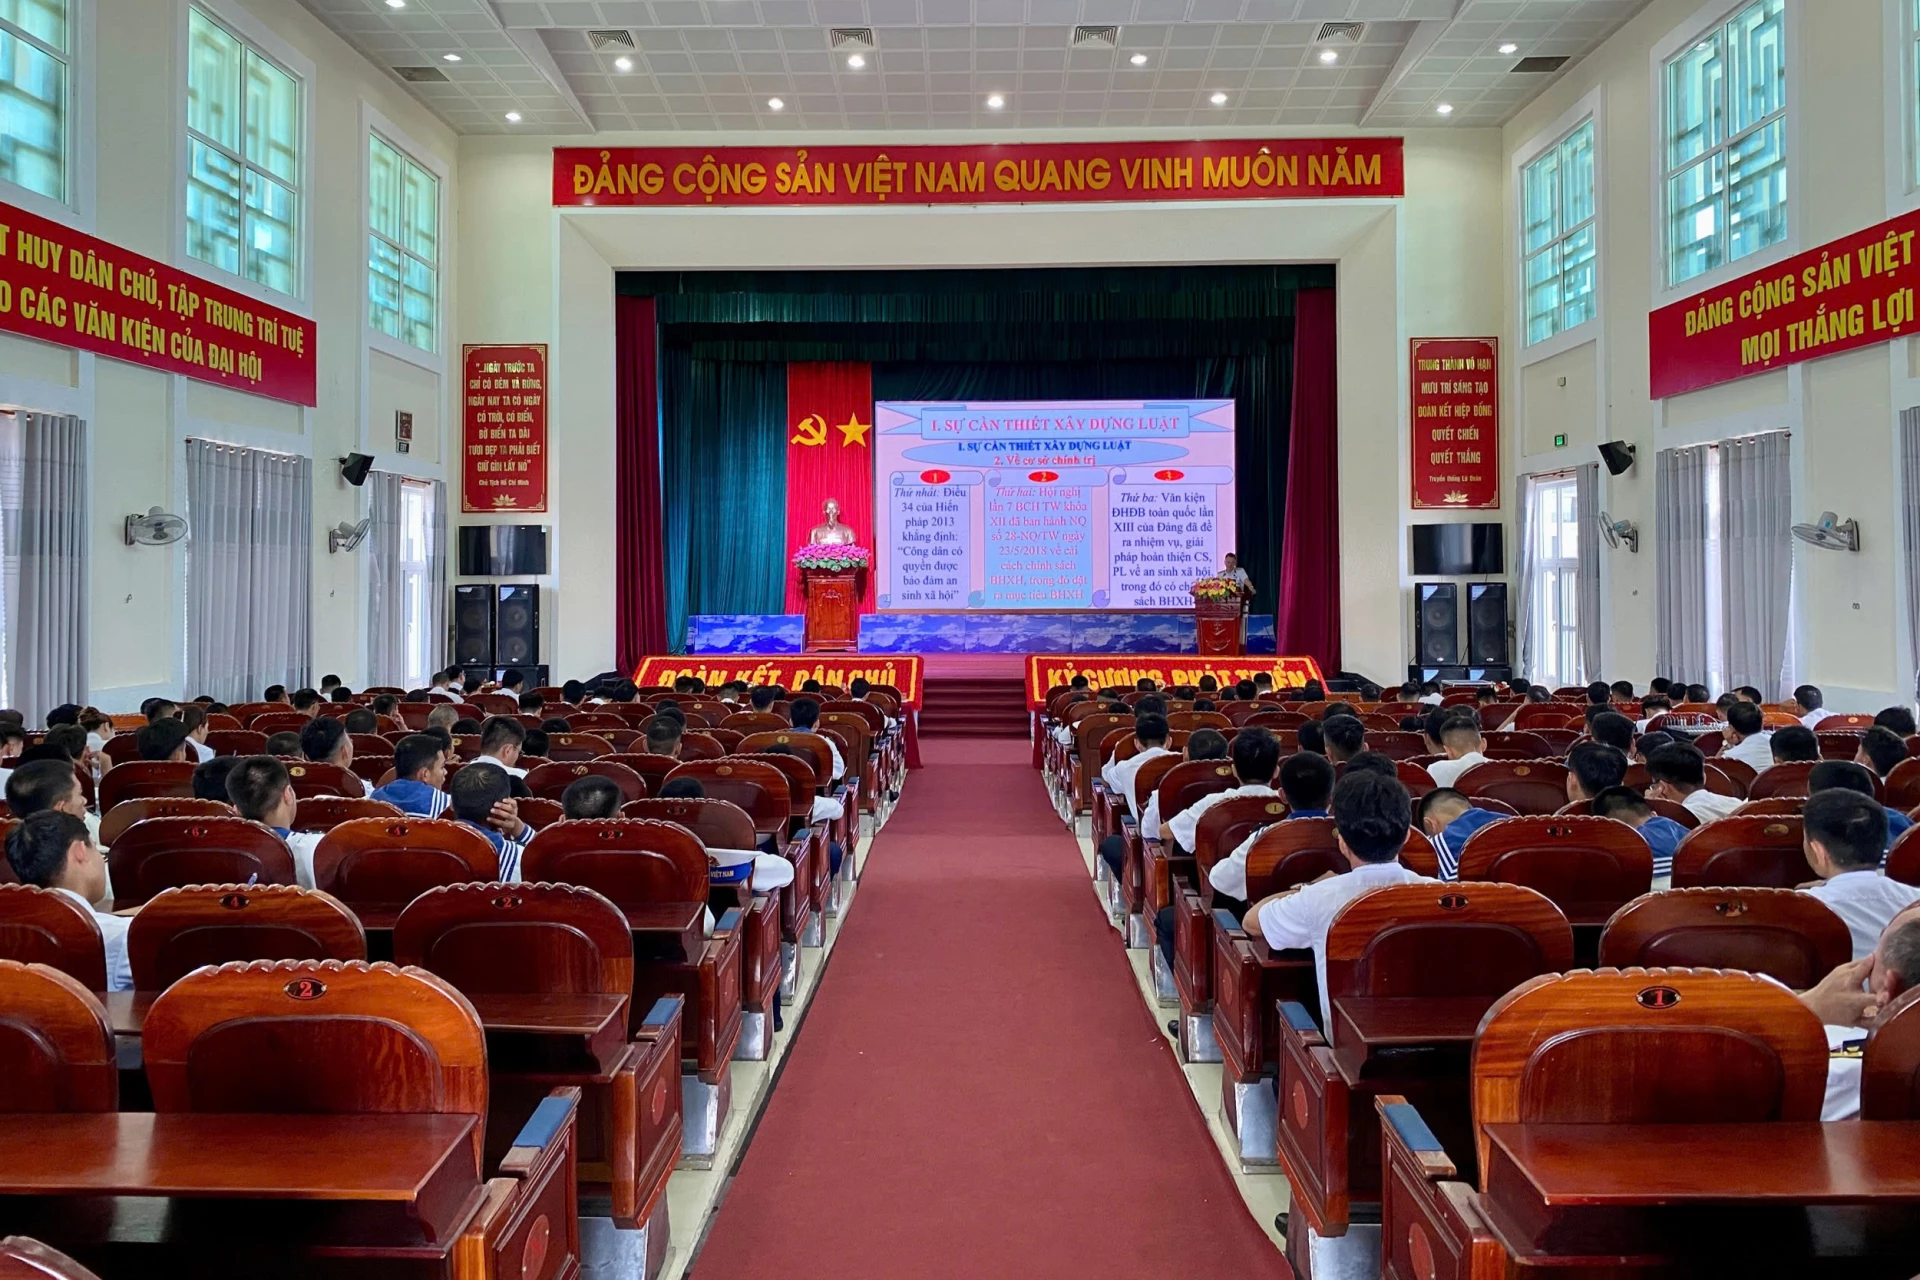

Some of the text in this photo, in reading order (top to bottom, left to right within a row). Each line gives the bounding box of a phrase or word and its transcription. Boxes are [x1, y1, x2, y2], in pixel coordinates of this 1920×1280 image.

[574, 146, 1381, 202] ĐẢNG CỘNG SẢN VIỆT NAM QUANG VINH MUÔN NĂM
[1685, 230, 1915, 337] ĐẢNG CỘNG SẢN VIỆT
[18, 230, 63, 274] HUY
[70, 249, 113, 291] DÂN
[120, 268, 162, 310] CHỦ,
[168, 284, 199, 321] TẬP
[204, 298, 253, 336] TRUNG
[257, 316, 278, 346] TRÍ
[282, 325, 304, 358] TUỆ
[1742, 288, 1914, 366] MỌI THẮNG LỢI
[20, 286, 66, 328] CÁC
[73, 300, 115, 341] VĂN
[122, 317, 165, 357] KIỆN
[170, 328, 204, 365] CỦA
[209, 343, 234, 377] ĐẠI
[238, 351, 262, 384] HỘI
[1418, 359, 1439, 370] TRUNG
[1442, 357, 1464, 370] THÀNH
[1477, 359, 1491, 372] HẠN
[1421, 380, 1488, 395] MƯU TRÍ SÁNG TẠO
[488, 394, 540, 406] NAY TA CÓ NGÀY
[1418, 404, 1436, 417] ĐOÀN
[1439, 401, 1451, 417] KẾT
[1455, 404, 1470, 419] HIỆP
[477, 410, 515, 423] CÓ CÓ
[932, 416, 1179, 434] I. SỰ CẦN THIẾT XÂY DỰNG LUẬT
[509, 426, 530, 439] TA DÀI
[1432, 425, 1478, 441] QUYẾT CHIẾN
[509, 442, 524, 455] PHẢI
[958, 440, 1131, 453] I. SỰ CẦN THIẾT XÂY DỰNG LUẬT
[994, 456, 1003, 465] 2.
[1007, 453, 1020, 465] Về
[1038, 456, 1048, 465] sở
[1052, 455, 1080, 465] chính
[1084, 456, 1096, 466] trị
[1431, 447, 1480, 464] QUYẾT THẮNG
[504, 458, 515, 471] LẤY
[932, 472, 938, 483] 1
[1041, 472, 1047, 482] 2
[1166, 471, 1172, 481] 3
[944, 486, 966, 497] Điều
[1161, 492, 1205, 504] Văn kiện
[902, 500, 959, 512] 34 Hiến
[1016, 502, 1039, 511] BCH
[1043, 502, 1060, 511] TW
[1112, 504, 1214, 519] ĐHĐB toàn quốc lần
[905, 517, 955, 529] pháp 2013
[1070, 516, 1087, 527] NQ
[1114, 522, 1183, 534] XIII của Đảng
[902, 530, 958, 543] khẳng định:
[1134, 537, 1203, 549] nhiệm vụ, giải
[932, 546, 948, 556] dân
[999, 546, 1047, 555] 23/5/2018
[1114, 551, 1212, 564] pháp hoàn thiện CS,
[902, 558, 958, 572] quyền được
[1001, 560, 1076, 570] cách sách
[1113, 566, 1178, 576] PL sinh
[903, 576, 944, 585] bảo đảm
[1050, 590, 1084, 599] BHXH
[1121, 583, 1145, 594] trong
[902, 590, 921, 600] sinh
[1134, 596, 1155, 606] sách
[193, 828, 198, 837] 6
[393, 826, 401, 834] 4
[608, 830, 614, 840] 2
[1556, 826, 1562, 836] 3
[230, 896, 238, 906] 4
[503, 898, 512, 908] 2
[1451, 896, 1456, 906] 1
[300, 982, 312, 997] 2
[1654, 990, 1663, 1004] 1
